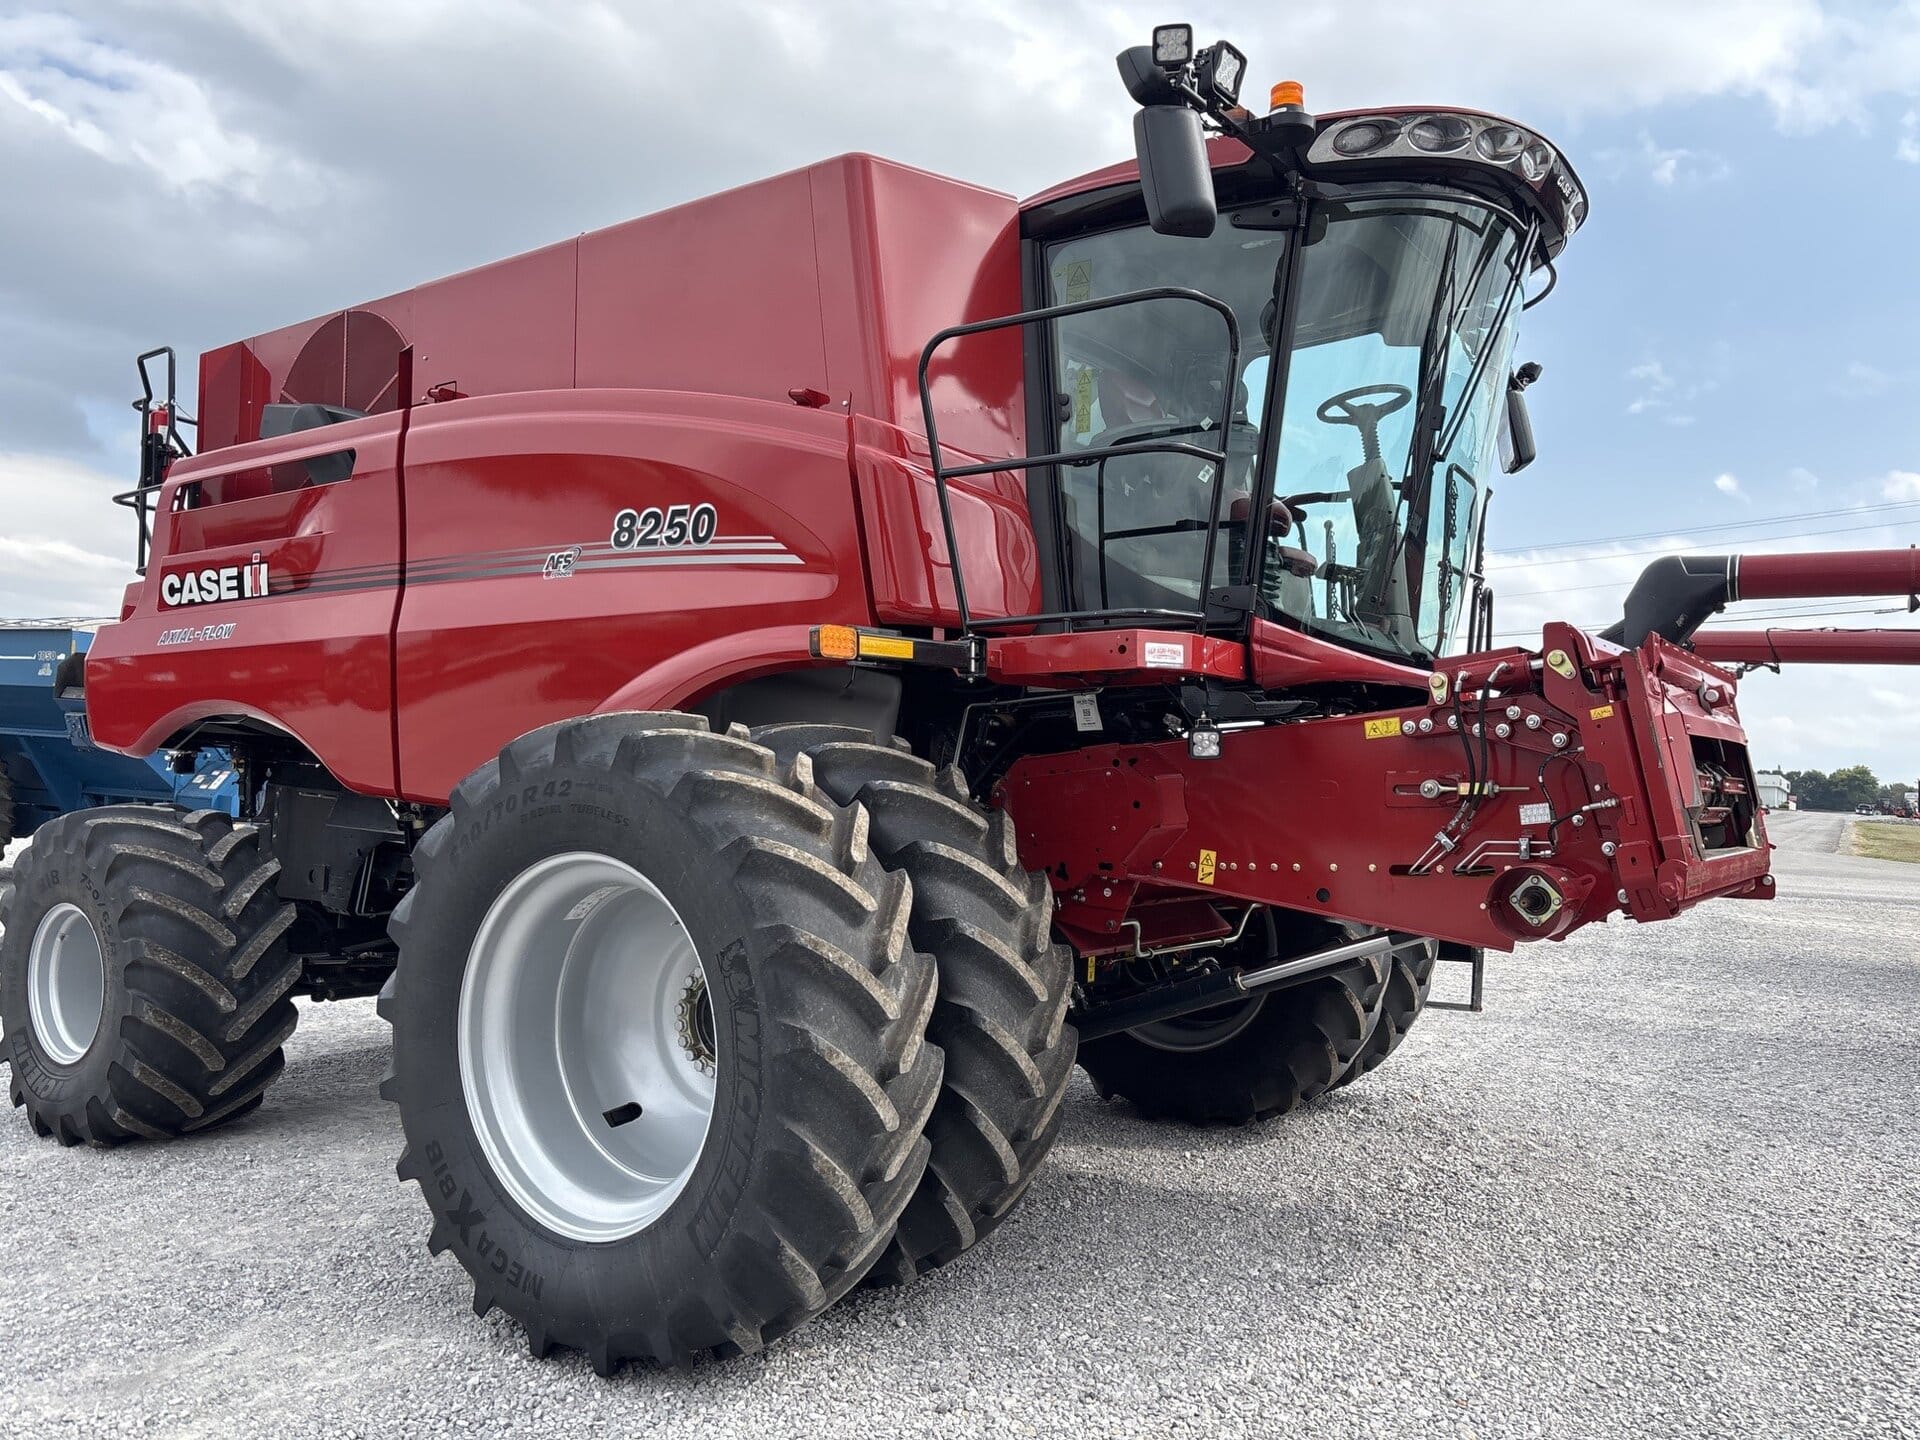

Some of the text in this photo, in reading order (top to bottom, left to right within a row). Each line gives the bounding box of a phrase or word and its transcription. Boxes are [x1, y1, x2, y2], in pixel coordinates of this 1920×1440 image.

[610, 502, 718, 551] 8250
[542, 550, 576, 573] AFS
[160, 566, 240, 607] CASE
[156, 622, 238, 647] AXIAL-FLOW
[569, 802, 632, 828] TUBELESS
